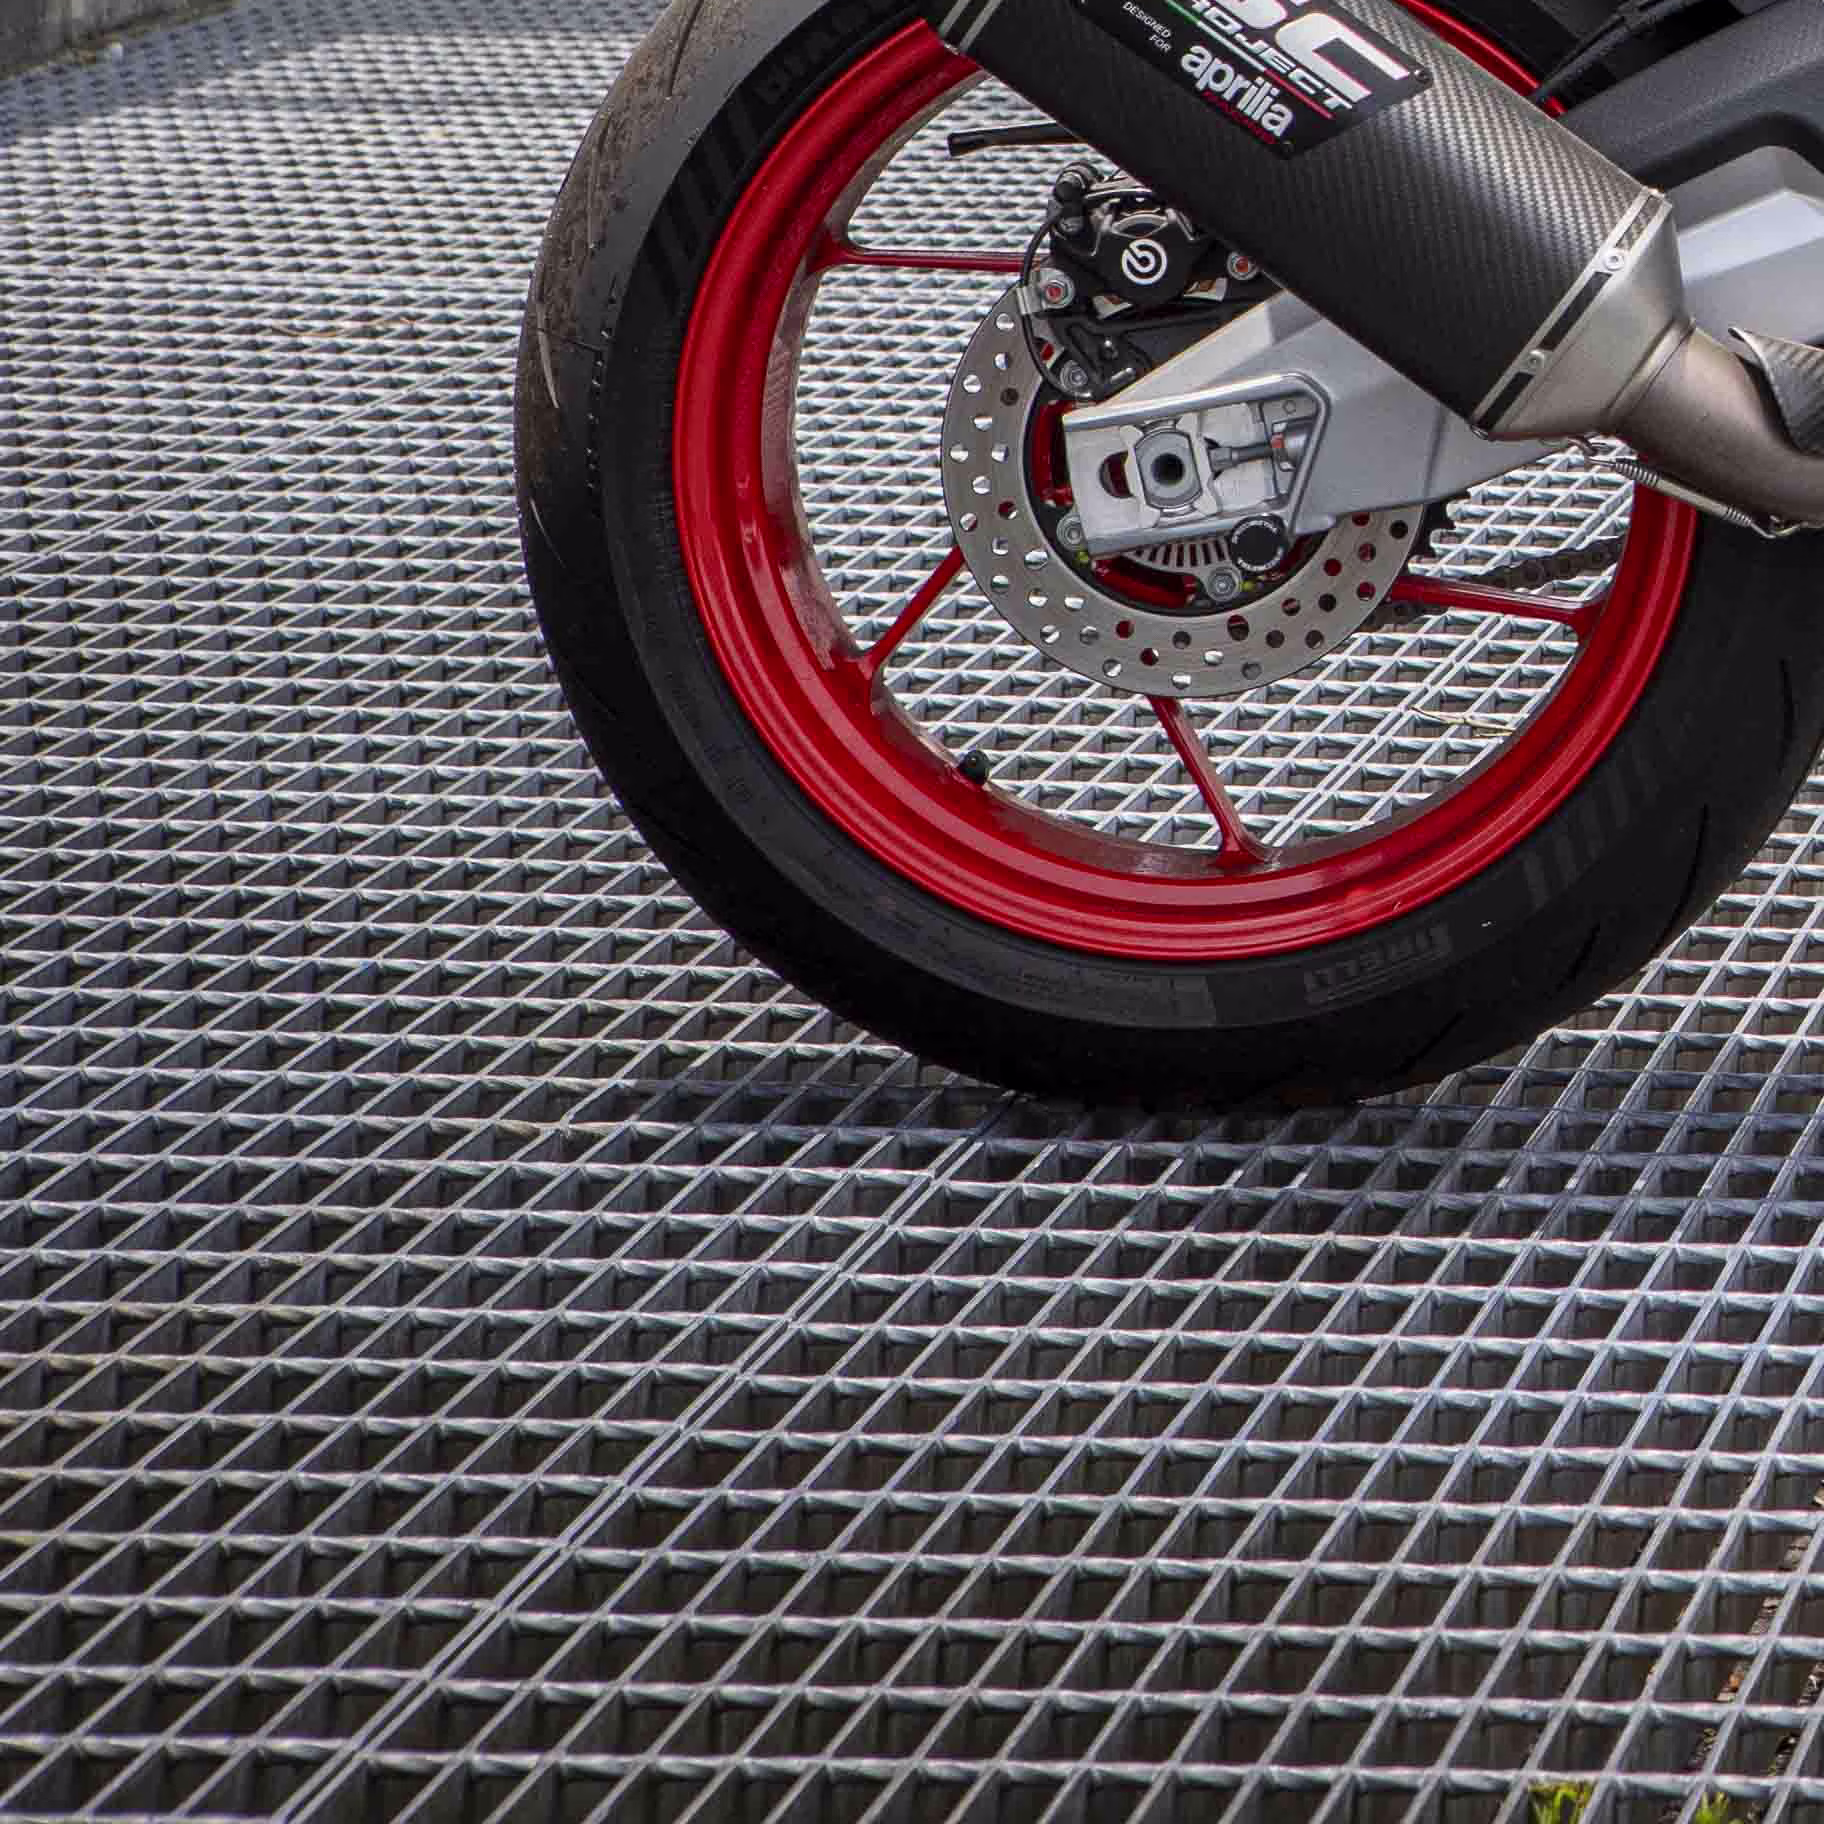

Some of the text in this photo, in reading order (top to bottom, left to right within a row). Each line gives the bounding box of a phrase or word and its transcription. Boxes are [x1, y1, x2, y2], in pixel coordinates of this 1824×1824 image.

[1122, 0, 1173, 39] DESIGNED
[1149, 33, 1173, 54] FOR
[1181, 45, 1294, 138] aprilia
